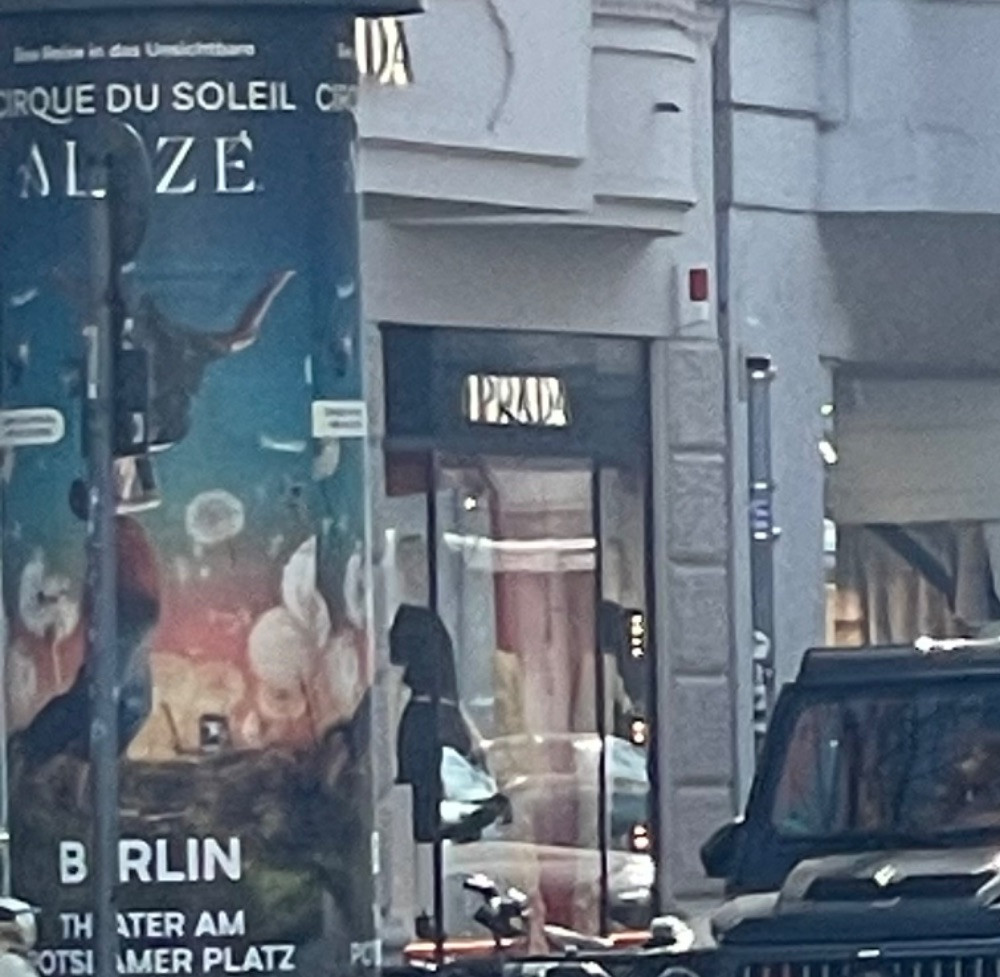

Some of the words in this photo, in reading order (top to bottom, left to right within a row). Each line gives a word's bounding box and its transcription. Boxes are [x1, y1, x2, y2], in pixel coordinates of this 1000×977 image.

[106, 83, 159, 113] DU
[171, 80, 297, 111] SOLEIL
[18, 129, 258, 198] ALZÉ
[59, 836, 242, 885] BRLIN
[59, 910, 186, 939] THATER
[194, 909, 246, 937] AM
[203, 943, 296, 974] PLATZ
